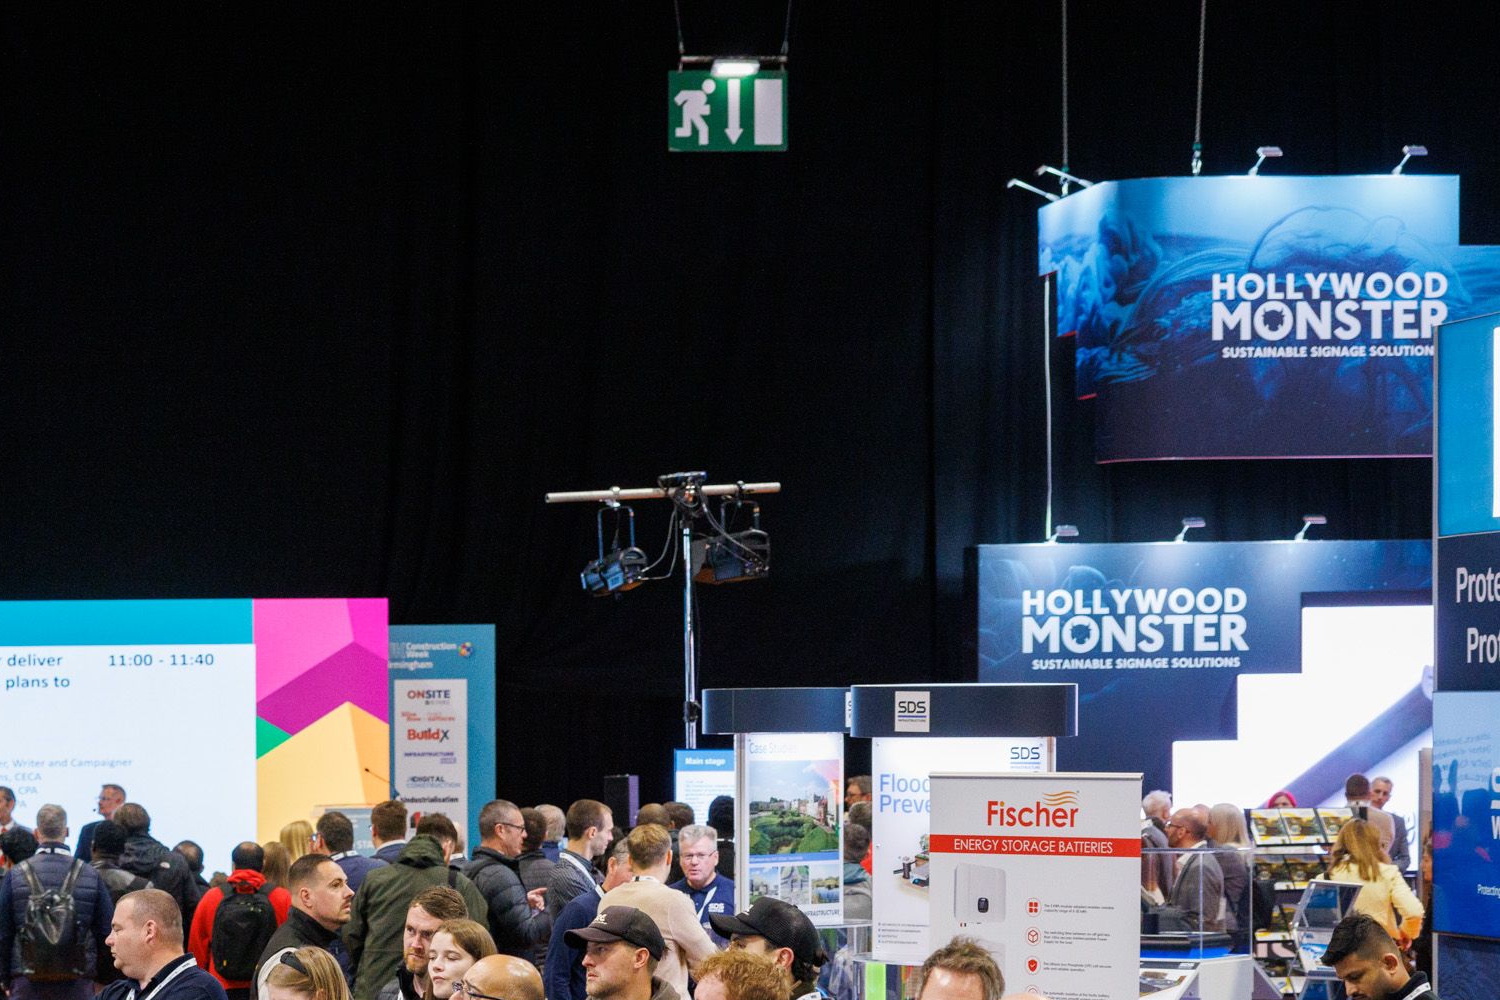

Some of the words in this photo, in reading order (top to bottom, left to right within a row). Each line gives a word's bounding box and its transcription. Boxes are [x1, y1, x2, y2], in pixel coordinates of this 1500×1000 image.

[1212, 272, 1448, 300] HOLLYWOOD
[1212, 300, 1448, 341] MONSTER
[1222, 346, 1307, 359] SUSTAINABLE
[1311, 346, 1366, 358] SIGNAGE
[1369, 344, 1434, 357] SOLUTION
[1022, 587, 1248, 616] HOLLYWOOD
[1022, 614, 1249, 655] MONSTER
[406, 642, 457, 651] Construction
[7, 654, 63, 668] deliver
[108, 653, 154, 667] 11:00
[170, 652, 214, 667] 11:40
[1031, 657, 1112, 671] SUSTAINABLE
[1115, 658, 1169, 670] SIGNAGE
[1171, 656, 1241, 669] SOLUTIONS
[6, 675, 49, 692] plans
[53, 677, 71, 689] to
[407, 689, 451, 700] ONSITE
[898, 701, 927, 713] SDS
[407, 728, 450, 742] BuildX
[750, 743, 767, 753] Case
[1010, 747, 1041, 760] SDS
[13, 759, 45, 768] Writer
[48, 759, 68, 767] and
[71, 758, 133, 769] Campaigner
[685, 757, 704, 765] Main
[705, 758, 726, 767] stage
[15, 773, 42, 781] CECA
[987, 800, 1079, 828] Fischer
[953, 839, 999, 851] ENERGY
[1001, 840, 1056, 852] STORAGE
[1058, 841, 1114, 854] BATTERIES
